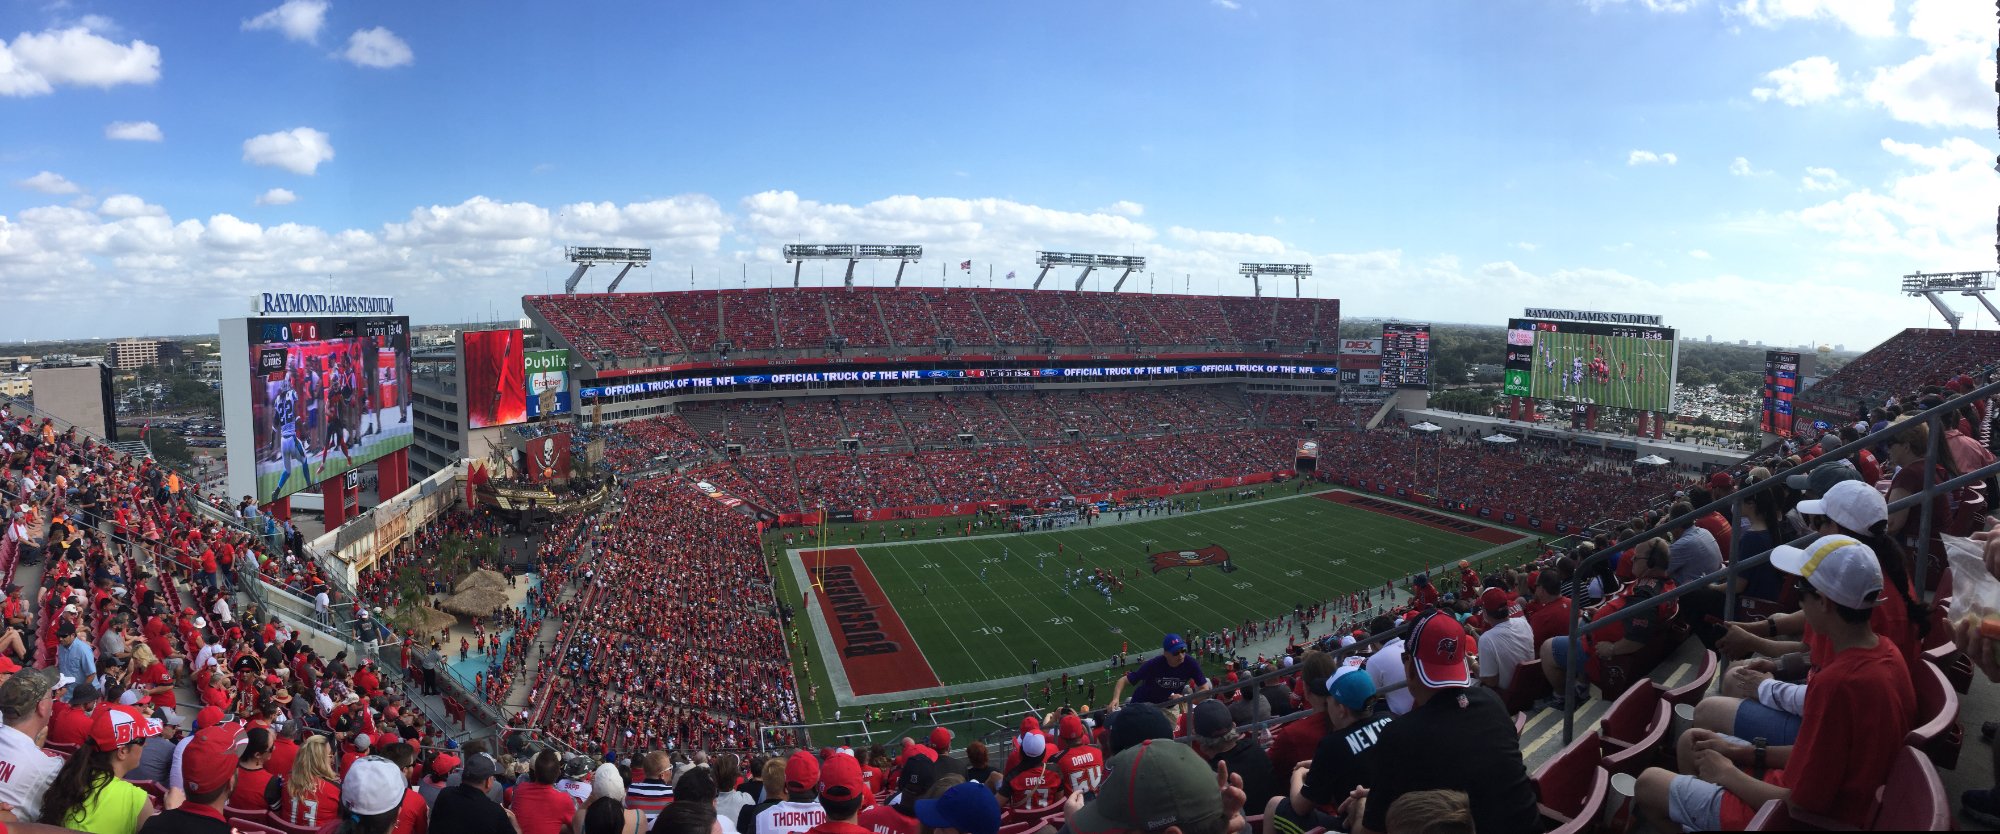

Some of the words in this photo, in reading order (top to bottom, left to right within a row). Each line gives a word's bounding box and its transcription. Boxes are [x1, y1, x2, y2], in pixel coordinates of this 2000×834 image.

[262, 292, 327, 313] RAYMOND
[328, 295, 358, 313] JAMES
[358, 296, 394, 313] STADIUM
[1525, 308, 1574, 320] RAYMOND
[1575, 310, 1608, 322] JAMES
[1610, 313, 1659, 325] STADIUM
[282, 326, 288, 340] 0
[309, 325, 316, 339] 0
[1642, 332, 1663, 340] 13:45
[1344, 340, 1374, 350] DEX
[524, 354, 567, 370] Publix
[1201, 364, 1234, 372] OFFICIAL
[771, 373, 819, 383] OFFICIAL
[823, 372, 858, 381] TRUCK
[862, 371, 876, 380] OF
[879, 371, 898, 380] THE
[902, 370, 920, 379] NFL
[1064, 368, 1102, 376] OFFICIAL
[1342, 371, 1356, 380] Lite
[605, 384, 645, 396] OFFICIAL
[648, 380, 674, 391] TRUCK
[677, 378, 689, 388] OF
[692, 377, 712, 386] THE
[716, 376, 737, 385] NFL
[348, 472, 357, 484] 19
[1050, 616, 1074, 625] 20
[981, 626, 1004, 636] 10
[1072, 753, 1094, 766] DAVID
[1025, 776, 1046, 786] EVANS
[291, 797, 318, 828] 13
[772, 810, 827, 827] THORNTON
[1148, 816, 1176, 830] Reebok
